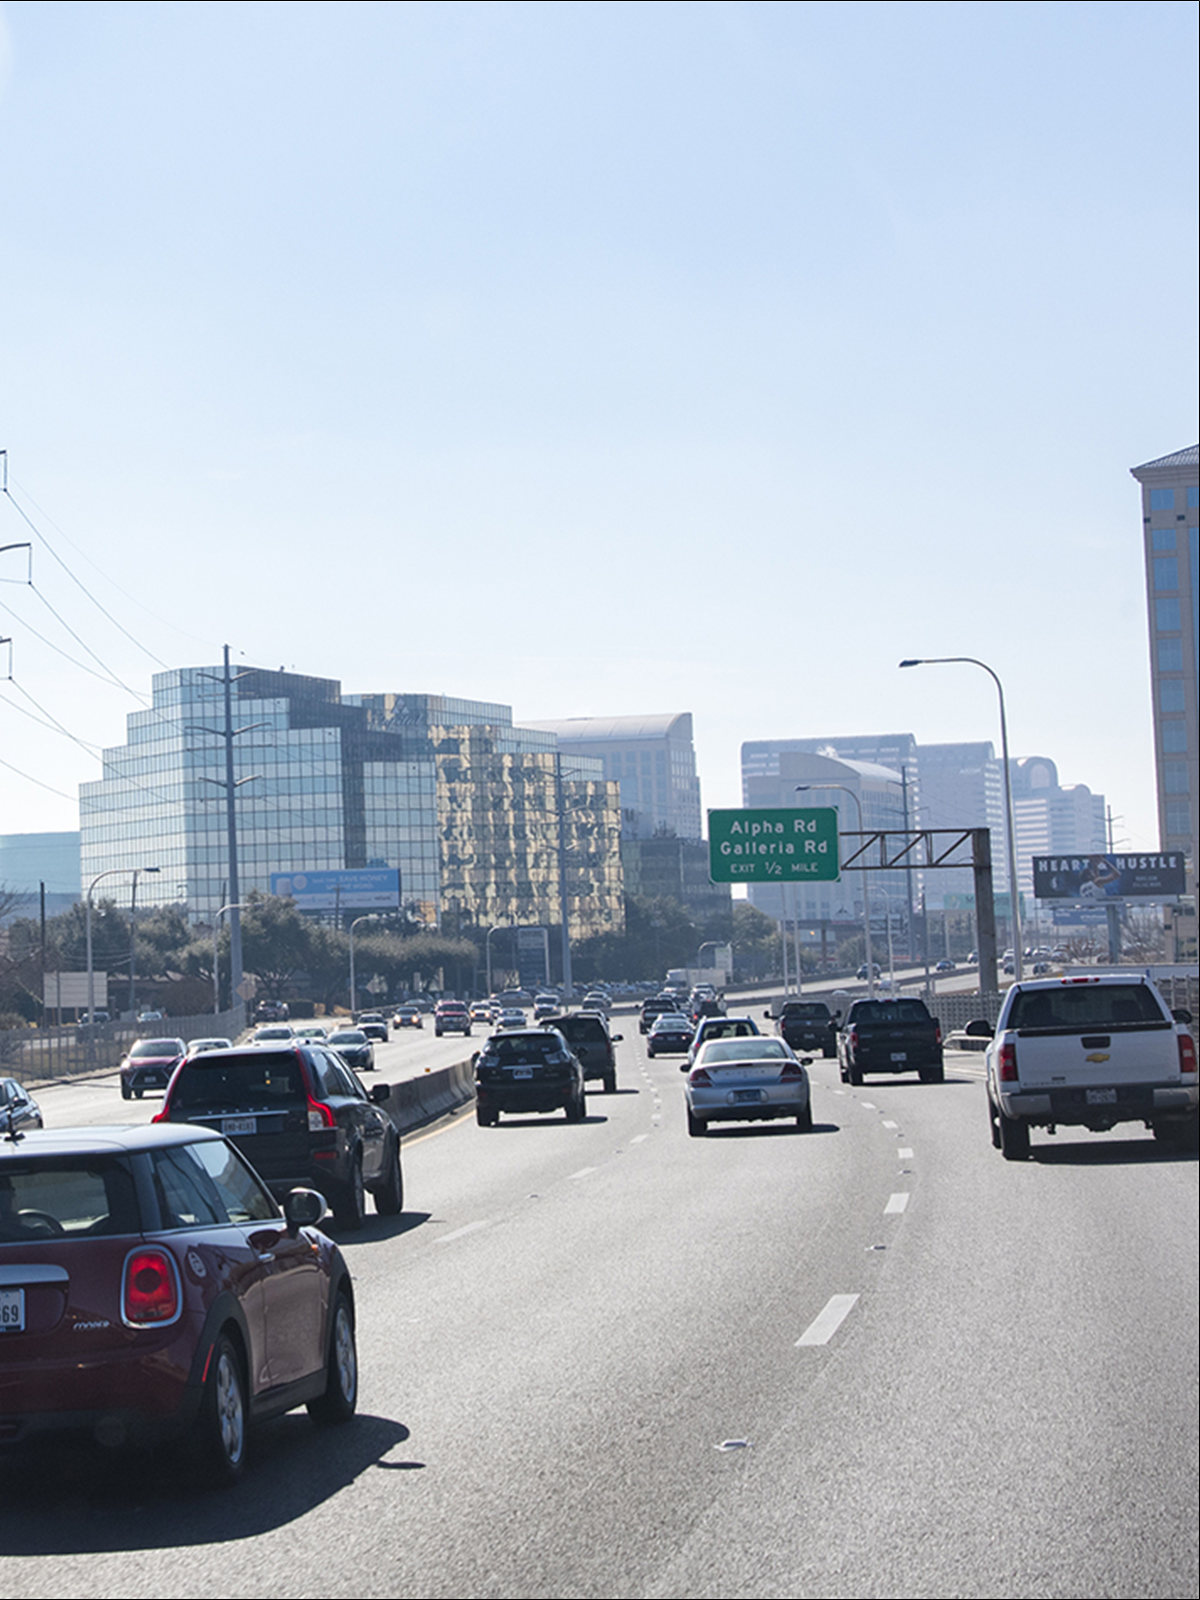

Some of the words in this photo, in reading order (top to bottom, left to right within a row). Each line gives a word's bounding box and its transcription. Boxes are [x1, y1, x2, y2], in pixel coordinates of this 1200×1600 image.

[730, 821, 784, 836] Alpha
[794, 819, 817, 833] Rd
[720, 841, 795, 855] Galleria
[804, 840, 828, 853] Rd
[730, 863, 755, 873] EXIT
[791, 862, 818, 872] MILE
[1038, 858, 1090, 872] HEART
[1116, 856, 1177, 869] HUSTLE
